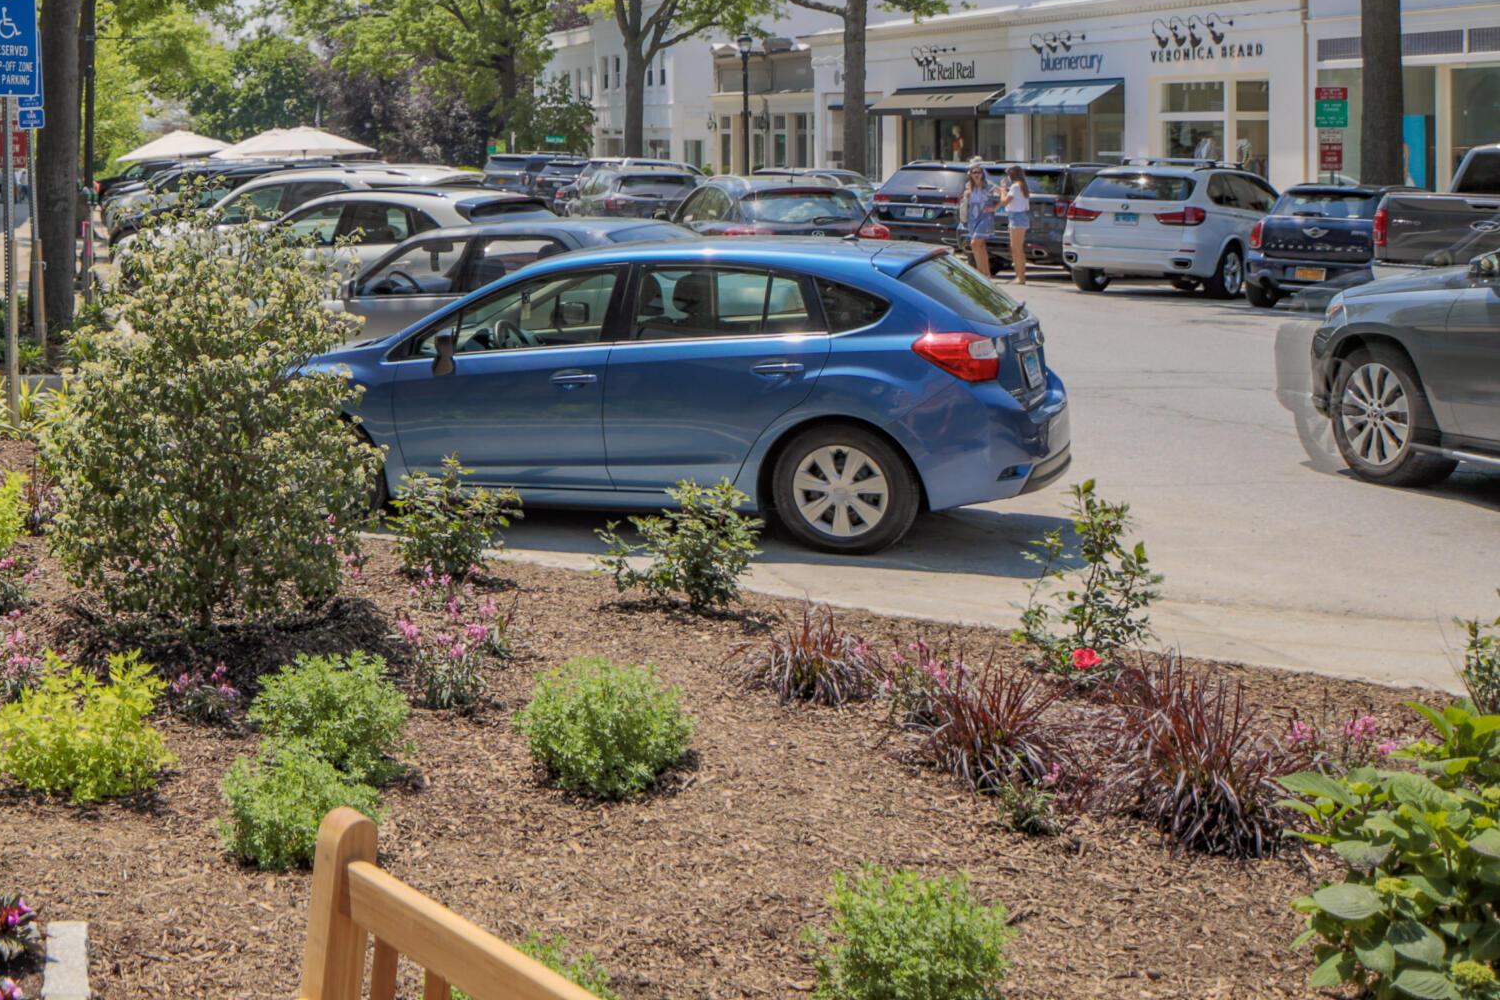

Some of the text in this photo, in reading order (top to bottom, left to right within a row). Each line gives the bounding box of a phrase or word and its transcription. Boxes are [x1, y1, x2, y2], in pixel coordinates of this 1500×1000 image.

[1040, 52, 1104, 74] bluemercury
[1150, 43, 1264, 63] VERONICA BEARD
[18, 61, 34, 73] ZONE
[921, 60, 975, 81] The Real Real
[1, 74, 31, 86] PARKING
